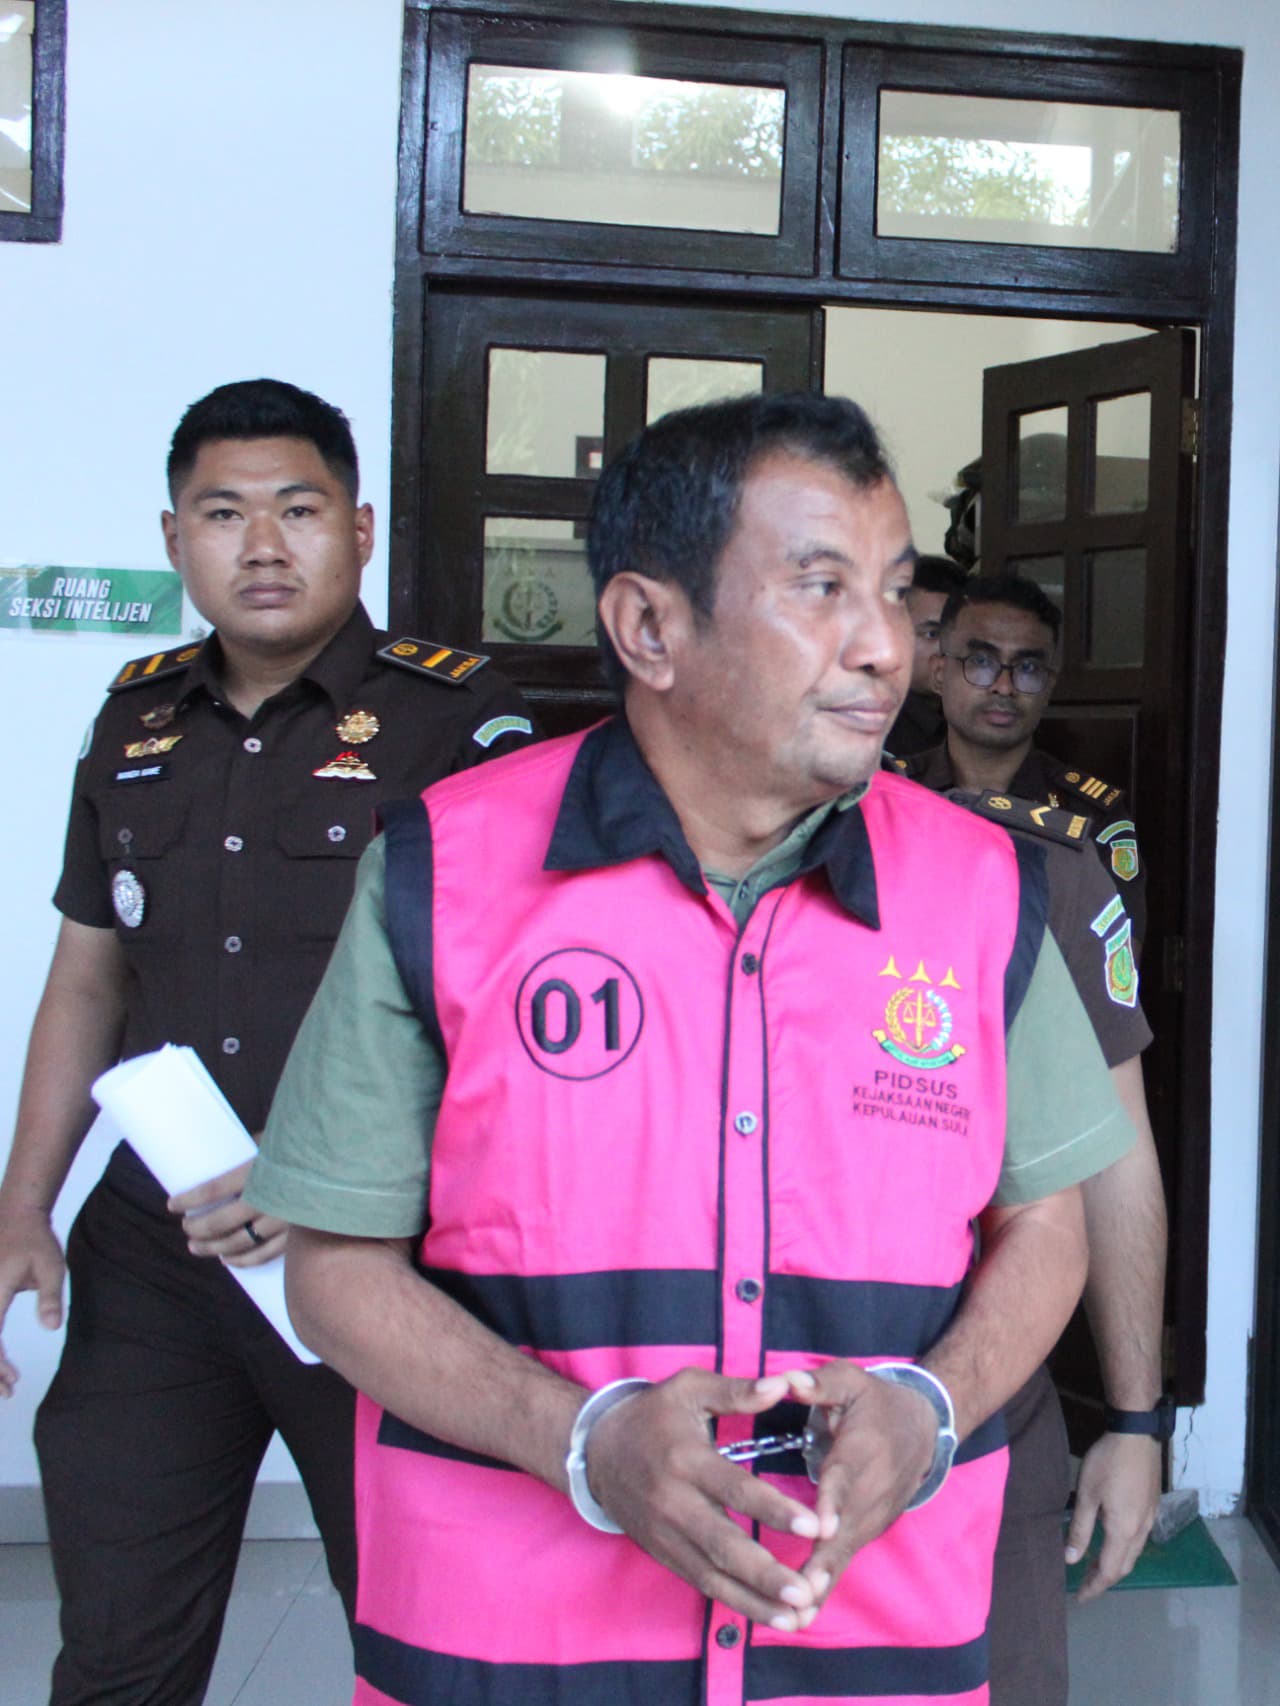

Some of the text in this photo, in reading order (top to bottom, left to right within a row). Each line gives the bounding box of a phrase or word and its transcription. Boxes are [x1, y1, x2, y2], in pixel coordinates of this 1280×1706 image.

[53, 577, 111, 598] RUANG
[9, 597, 152, 623] SEKSI INTELIJEN
[530, 978, 620, 1055] 01
[874, 1070, 958, 1100] PIDSUS
[853, 1086, 932, 1111] KEJAKSAAN
[853, 1103, 938, 1128] KEPULAUAN
